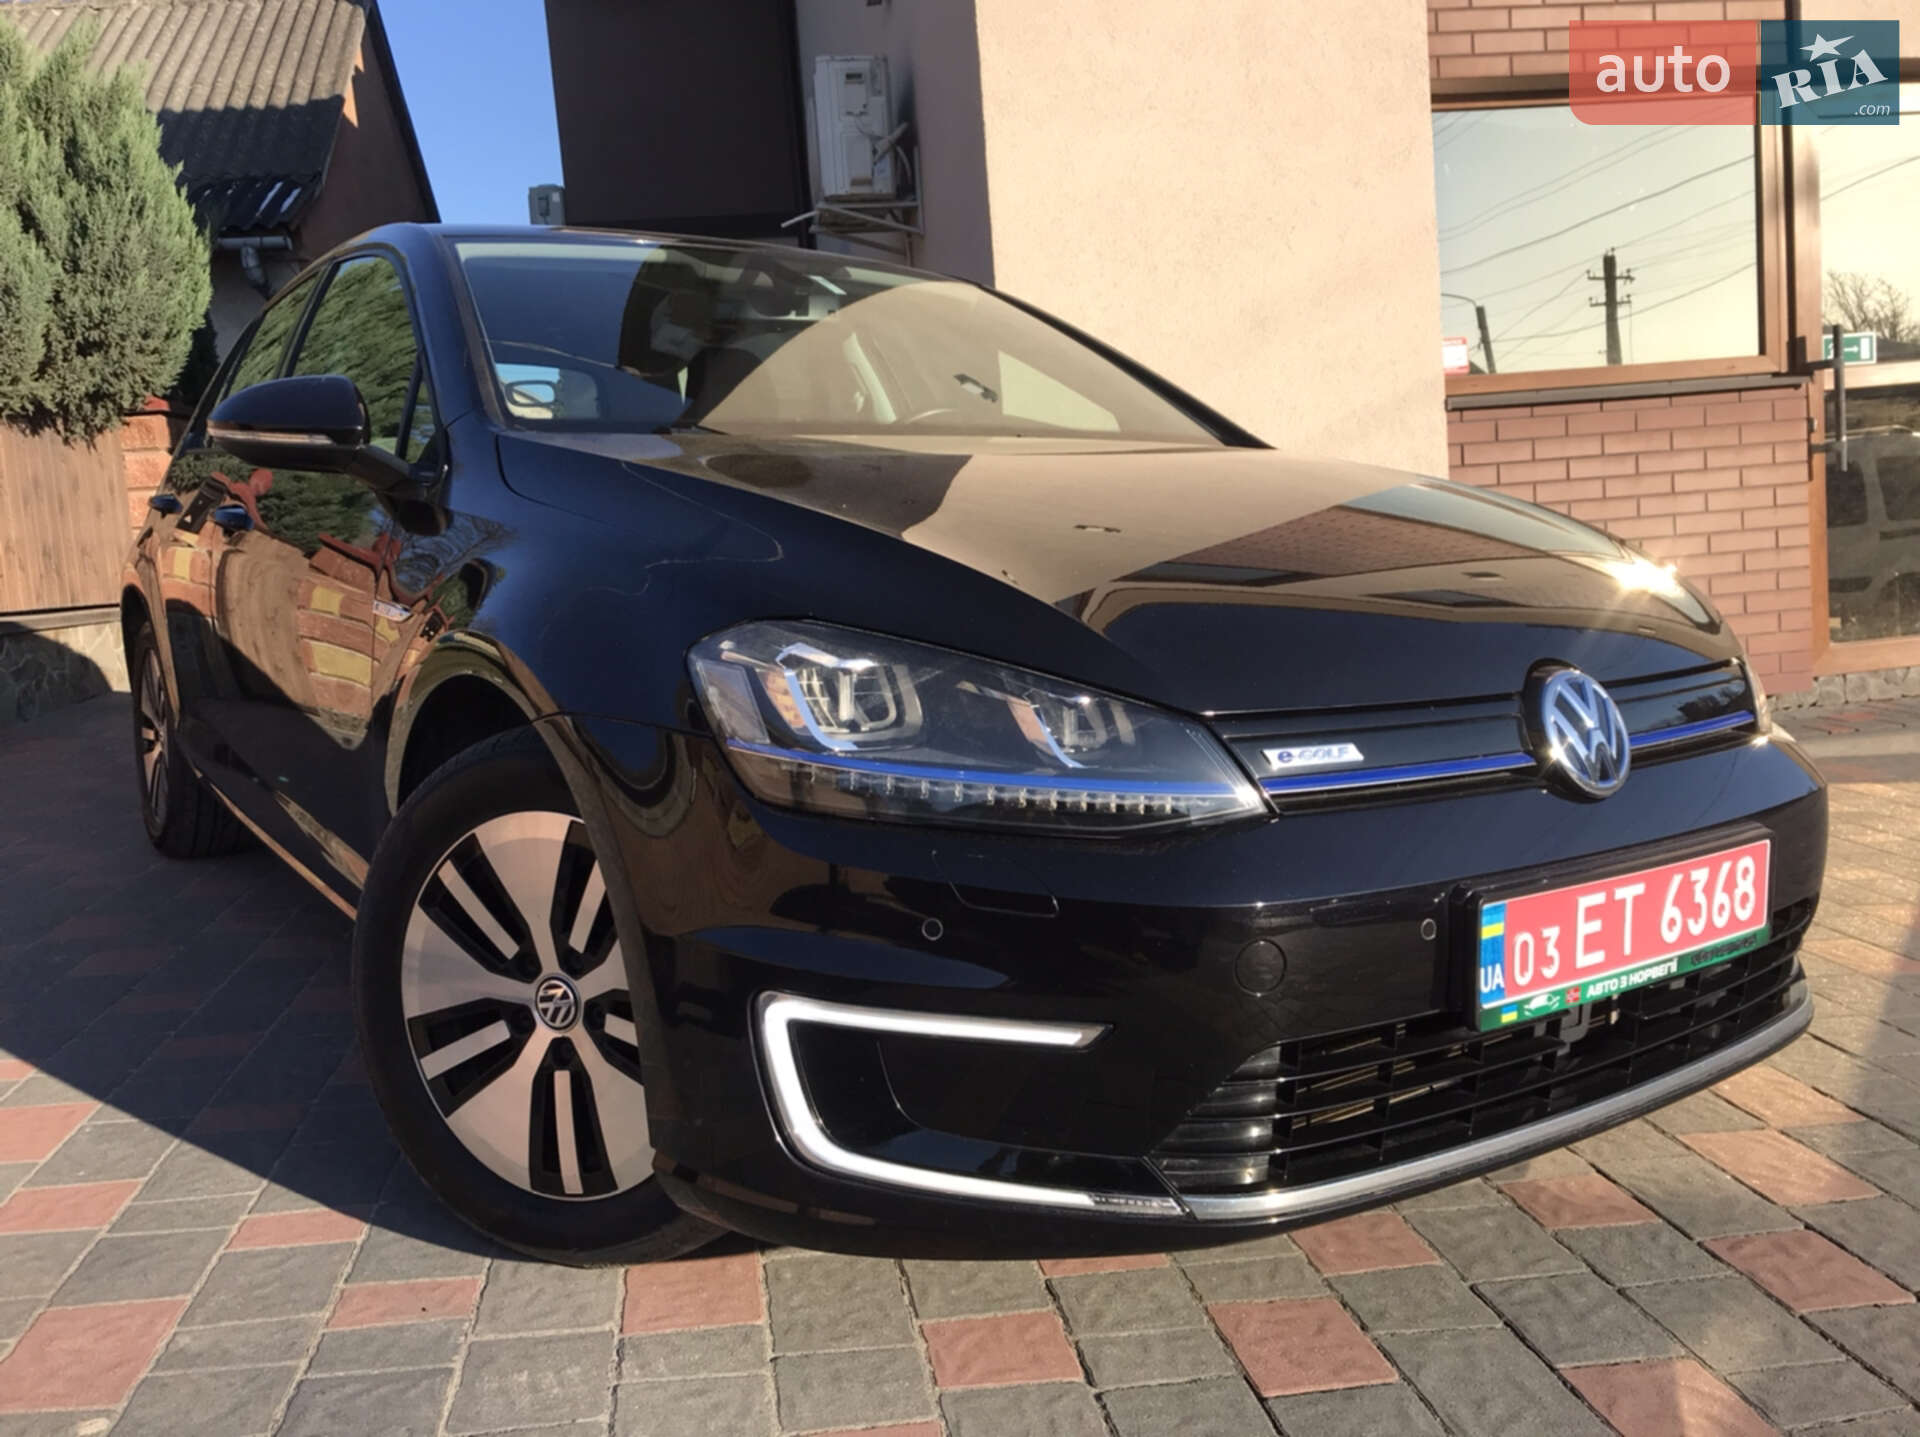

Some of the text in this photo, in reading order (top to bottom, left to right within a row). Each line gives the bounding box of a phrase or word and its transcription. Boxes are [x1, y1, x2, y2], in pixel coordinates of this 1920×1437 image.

[1513, 855, 1756, 987] 03 ET 6368
[1480, 963, 1505, 993] UA
